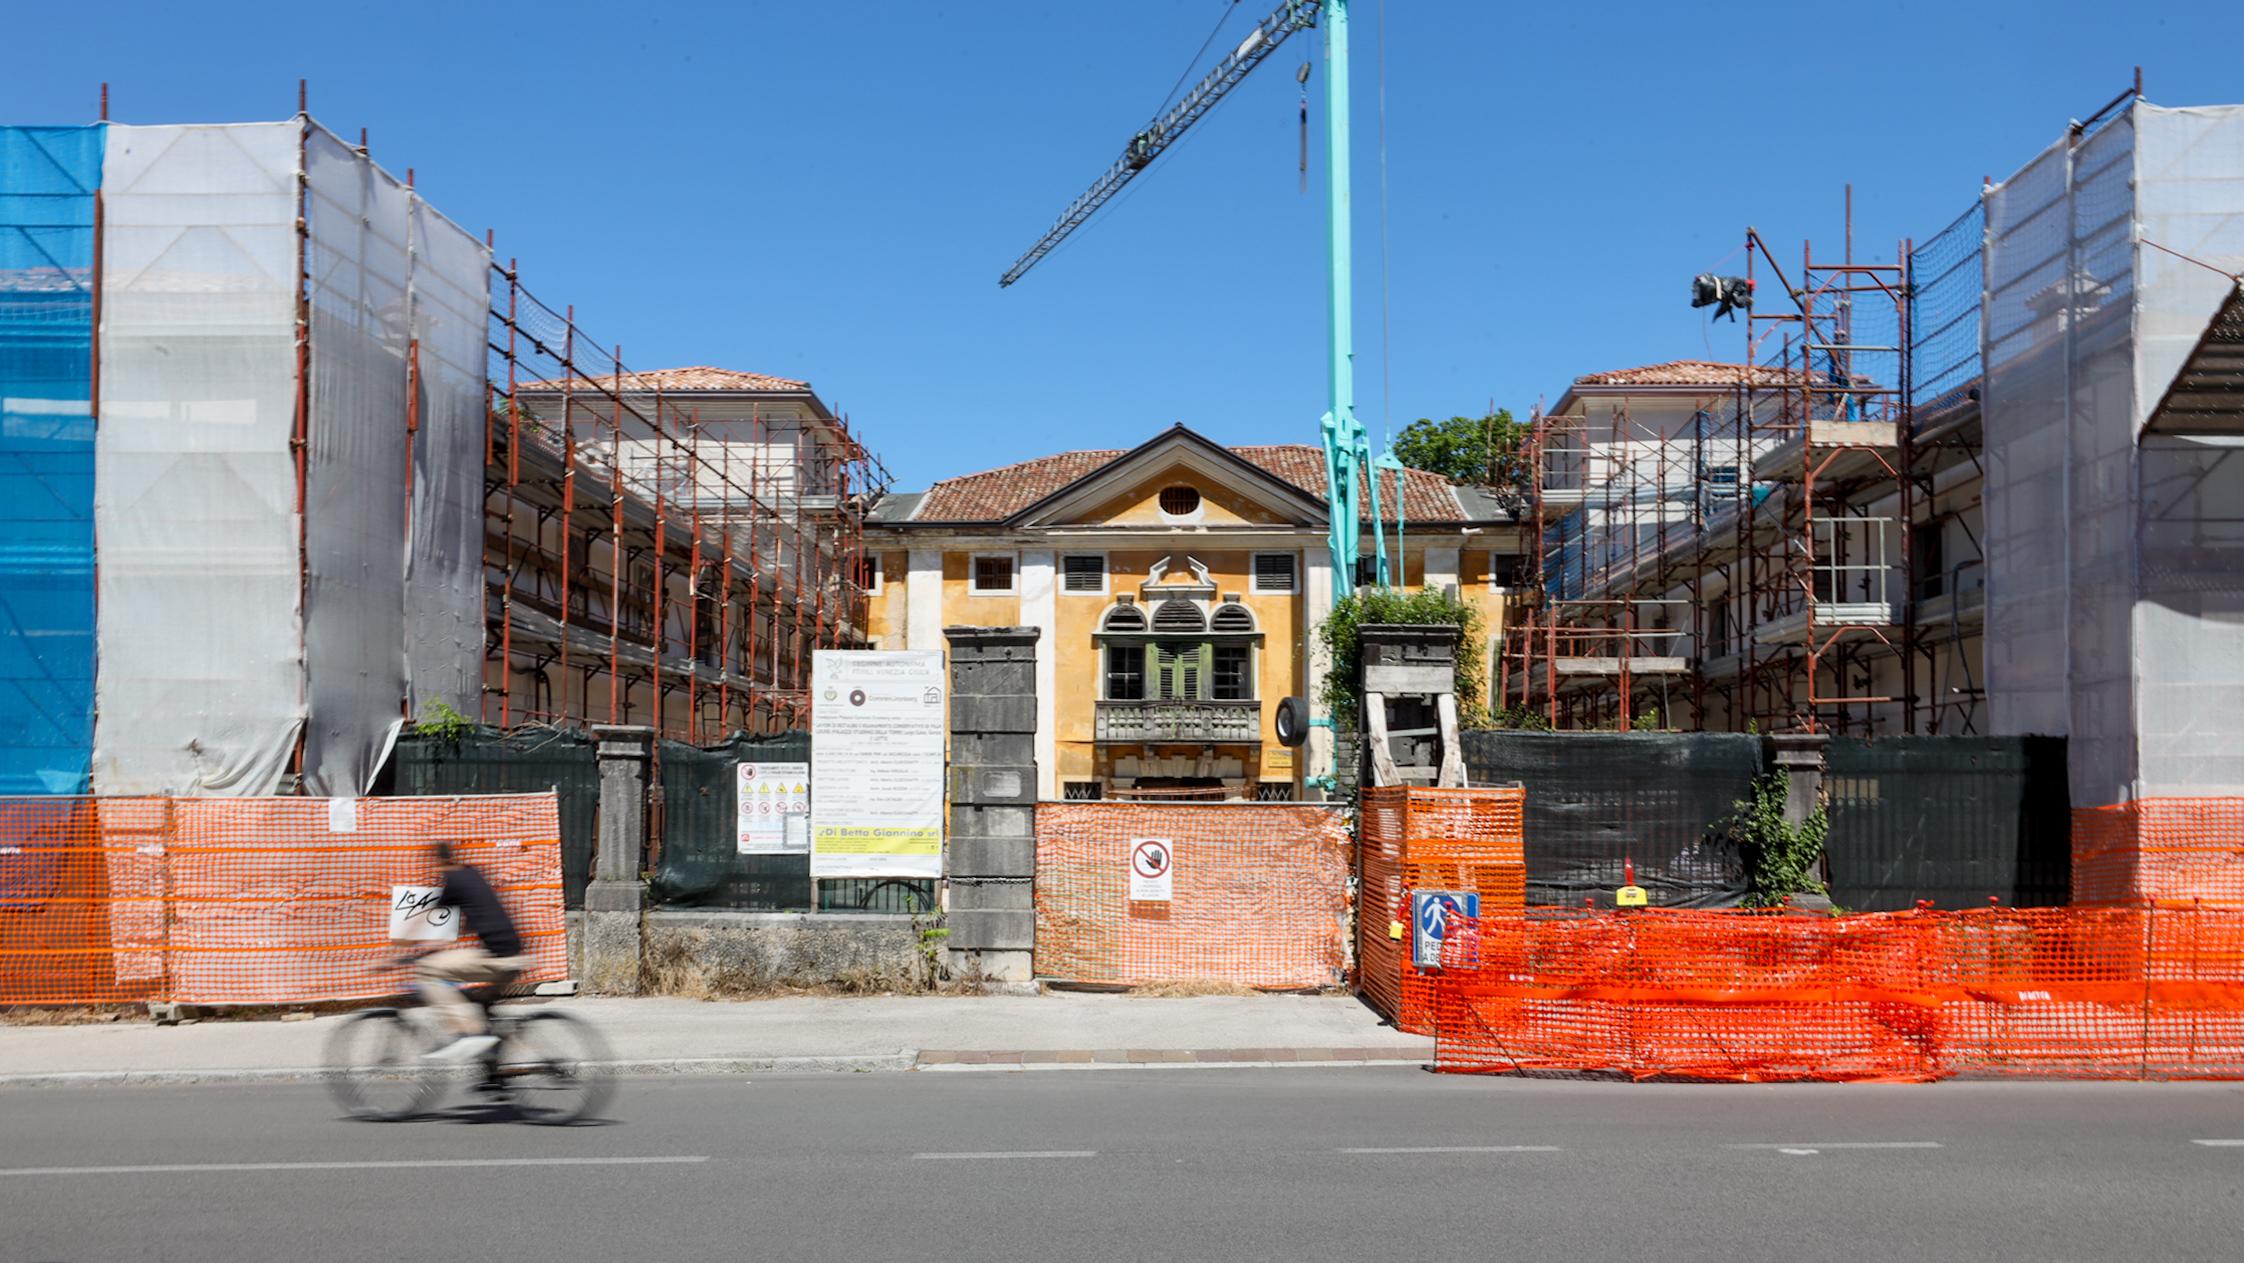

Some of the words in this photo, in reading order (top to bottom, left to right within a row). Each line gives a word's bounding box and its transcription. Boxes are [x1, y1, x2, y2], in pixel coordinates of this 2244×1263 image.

[825, 828, 837, 836] Di
[841, 828, 870, 837] Betta
[873, 828, 924, 837] Giannino
[1424, 941, 1443, 951] PED
